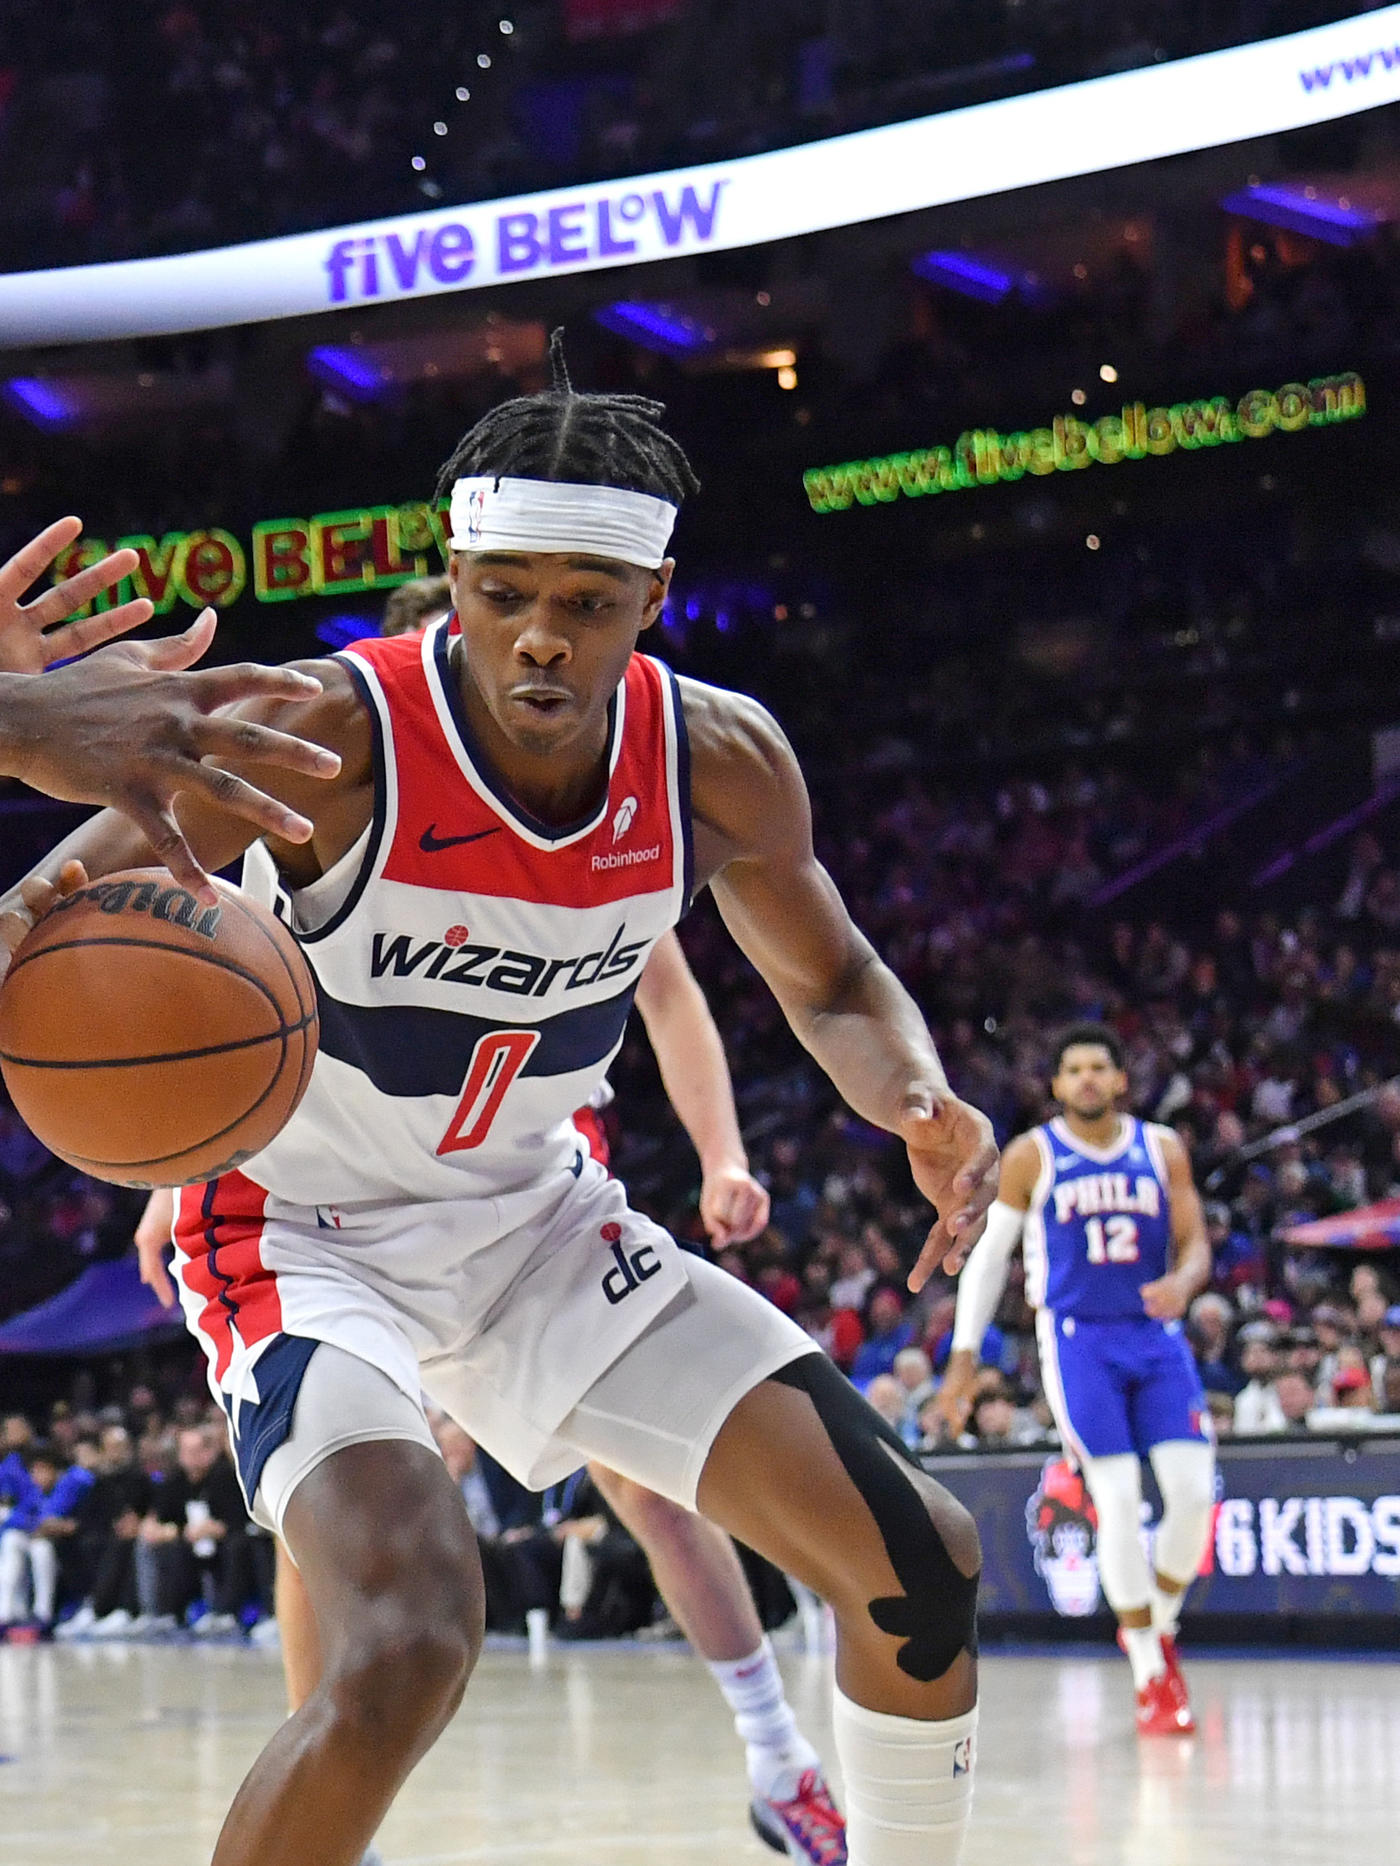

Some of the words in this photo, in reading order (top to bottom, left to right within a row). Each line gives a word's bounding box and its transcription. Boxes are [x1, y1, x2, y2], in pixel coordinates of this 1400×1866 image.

[325, 223, 476, 302] five
[496, 181, 723, 274] BELOW
[251, 497, 451, 603] BELO
[591, 844, 660, 872] Robinhood
[47, 880, 224, 941] Wil
[370, 923, 653, 997] wizards
[434, 1029, 542, 1157] 0
[1054, 1171, 1160, 1224] PHILA
[1084, 1214, 1140, 1265] 12
